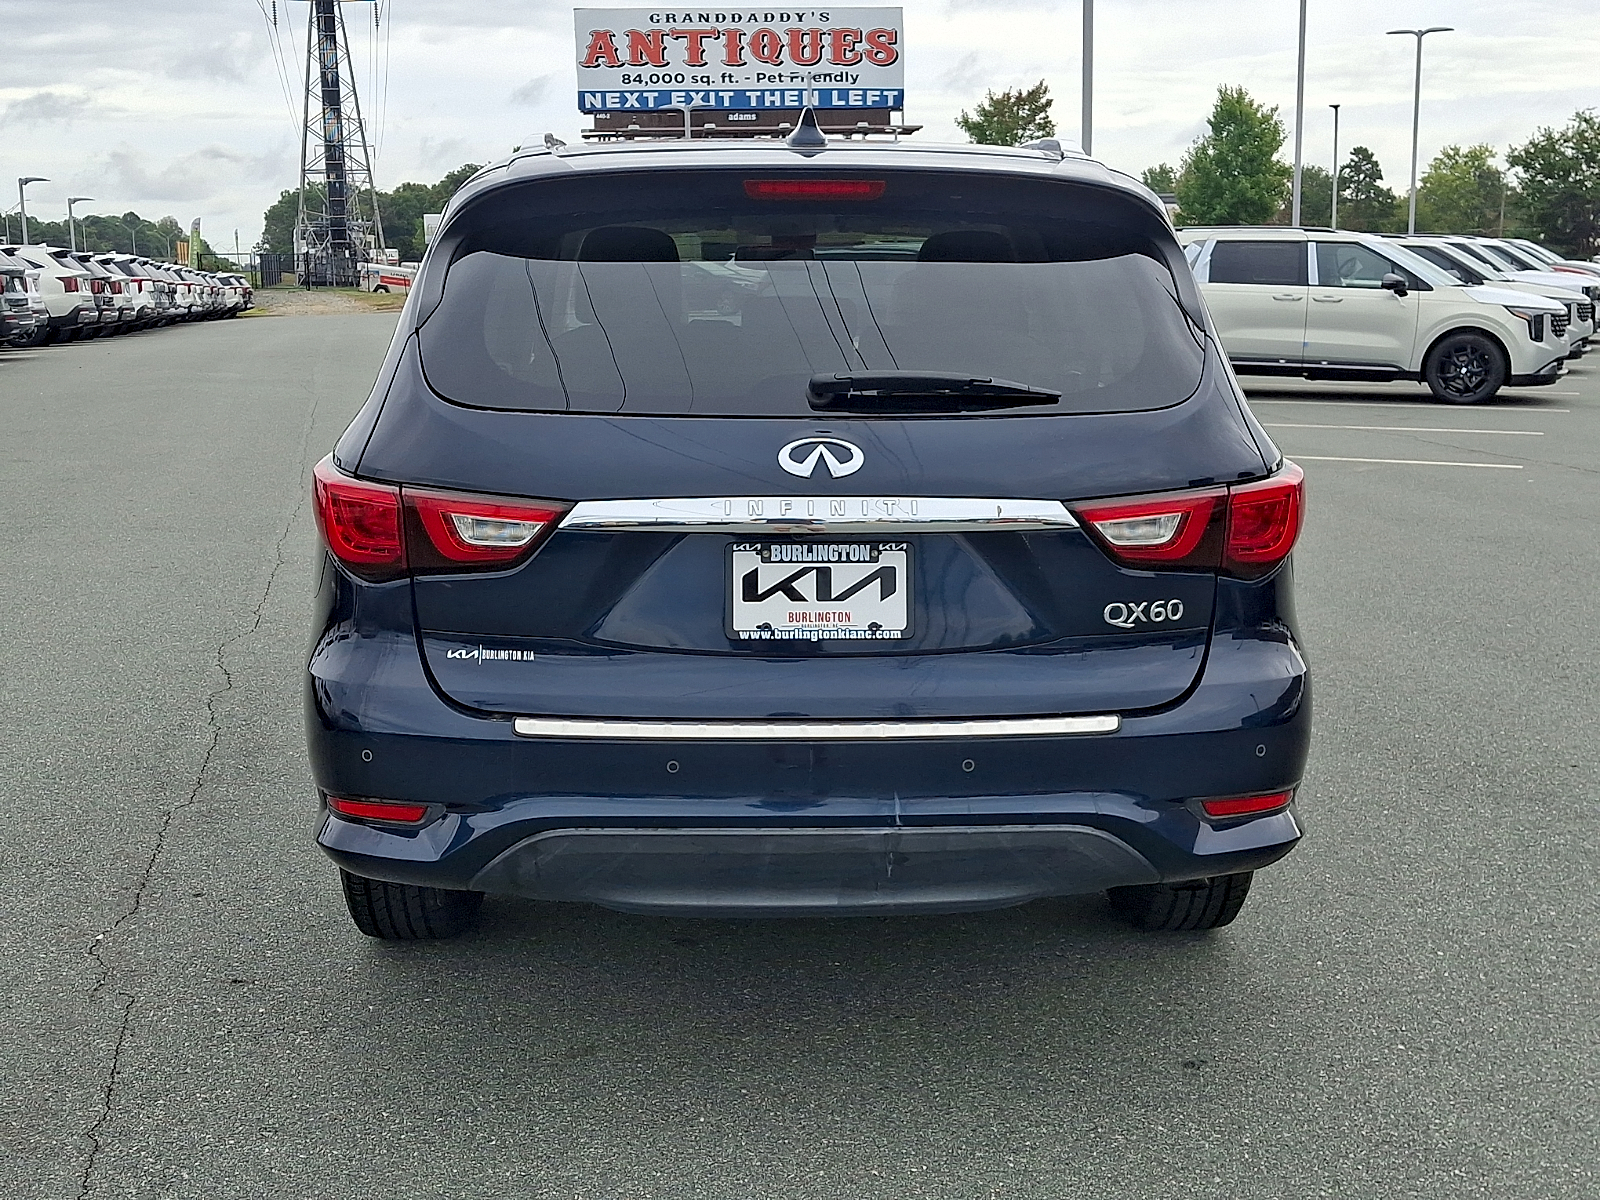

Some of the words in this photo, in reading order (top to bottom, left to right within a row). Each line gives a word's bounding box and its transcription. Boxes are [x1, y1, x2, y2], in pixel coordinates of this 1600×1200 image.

[650, 12, 830, 24] GRANDDADDY'S
[579, 26, 899, 68] ANTIQUES
[621, 73, 685, 86] 84,000
[691, 75, 715, 86] sq.
[721, 72, 739, 84] ft.
[756, 72, 784, 83] Pet
[790, 71, 859, 84] Frendly
[584, 92, 658, 108] NEXT
[671, 91, 734, 107] EXIT
[745, 91, 819, 106] THEN
[832, 91, 898, 106] LEFT
[728, 113, 756, 121] adams
[724, 500, 918, 516] INFINITI
[770, 545, 870, 562] BURLINGTON
[742, 566, 897, 602] KIA
[788, 611, 851, 623] BURLINGTON
[1103, 599, 1184, 628] QX60
[739, 629, 902, 642] www.burlingtonkianc.com
[482, 649, 521, 660] BURLINGTON
[523, 650, 535, 660] KIA
